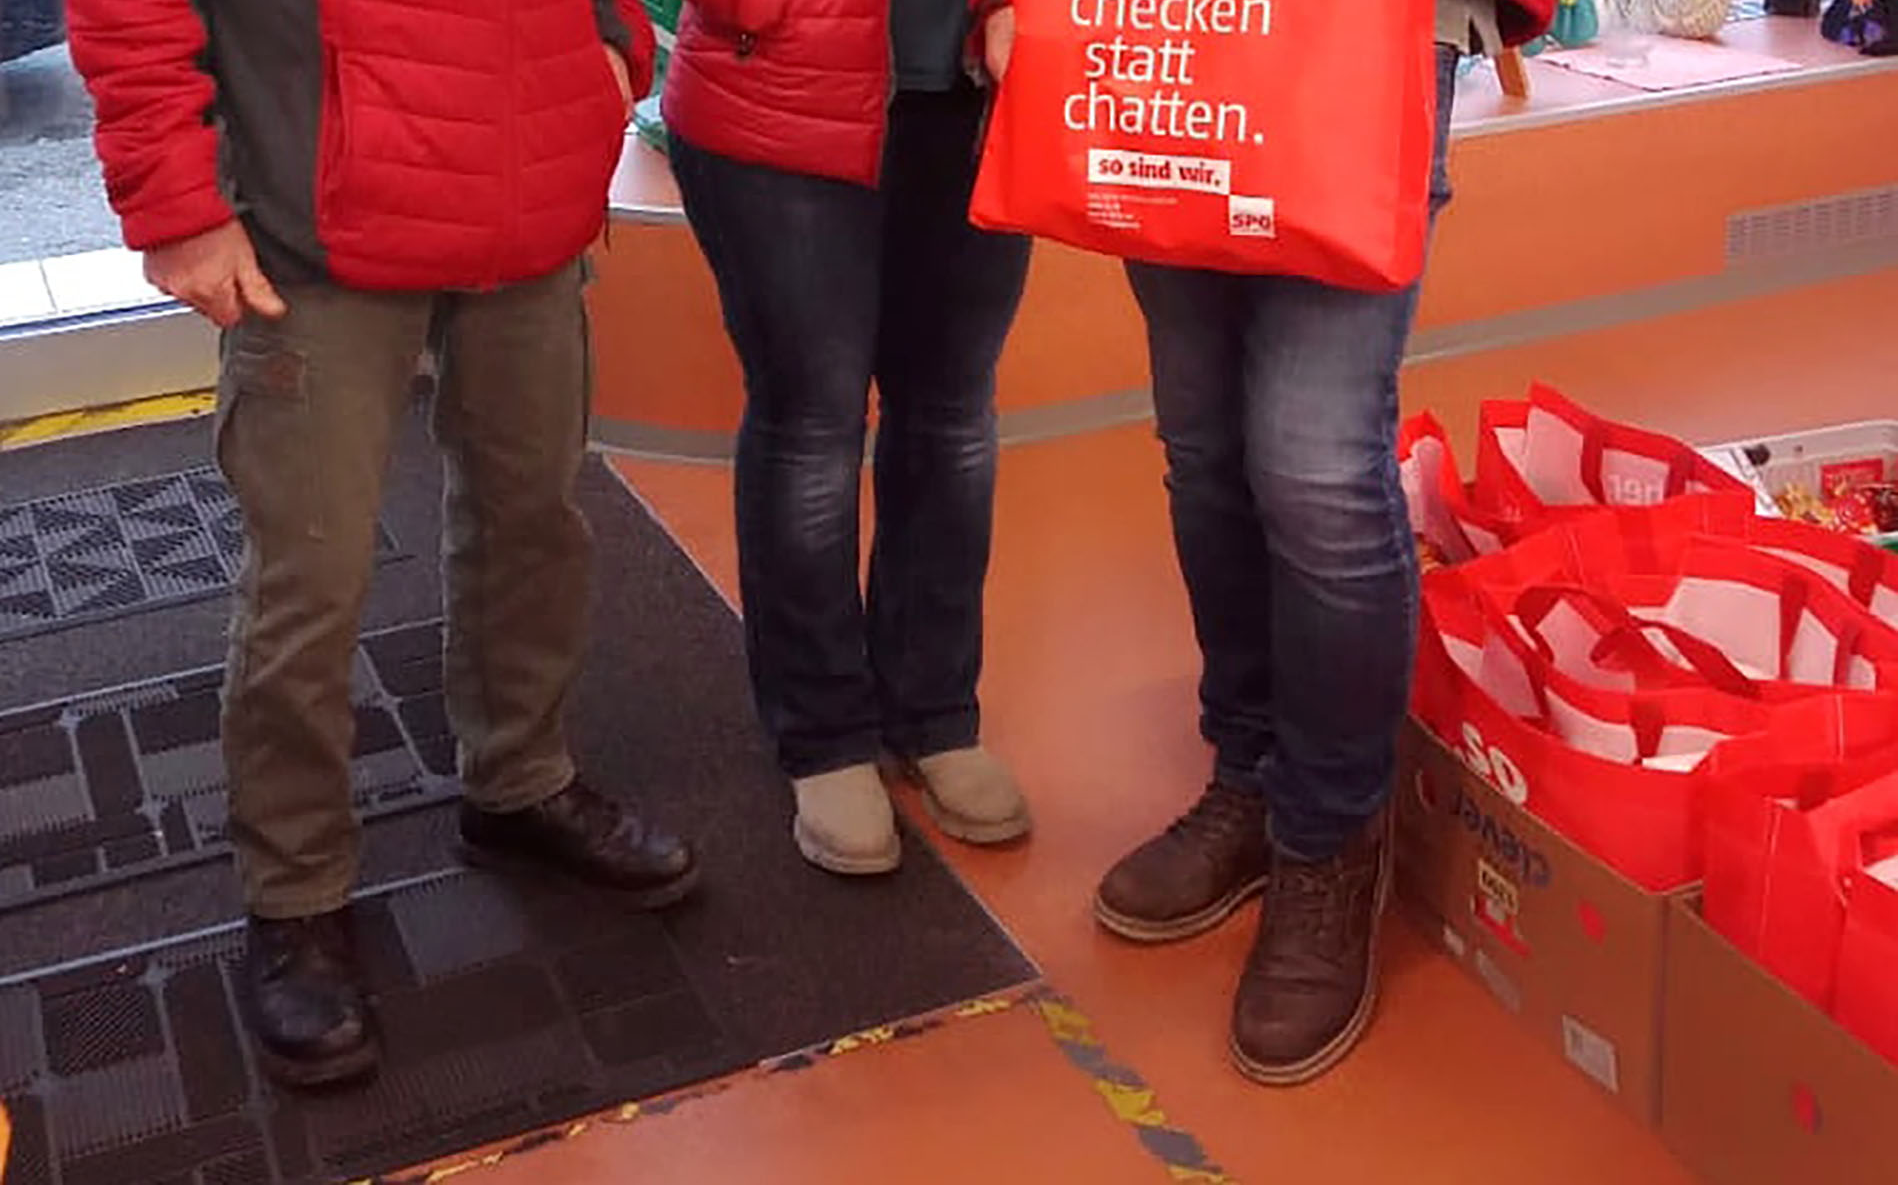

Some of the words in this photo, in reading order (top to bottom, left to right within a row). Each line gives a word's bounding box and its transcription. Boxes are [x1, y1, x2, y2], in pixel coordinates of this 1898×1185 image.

[1084, 35, 1196, 85] statt
[1064, 81, 1264, 145] chatten.
[1098, 158, 1124, 175] so
[1128, 156, 1171, 180] sind
[1178, 161, 1221, 187] wir.
